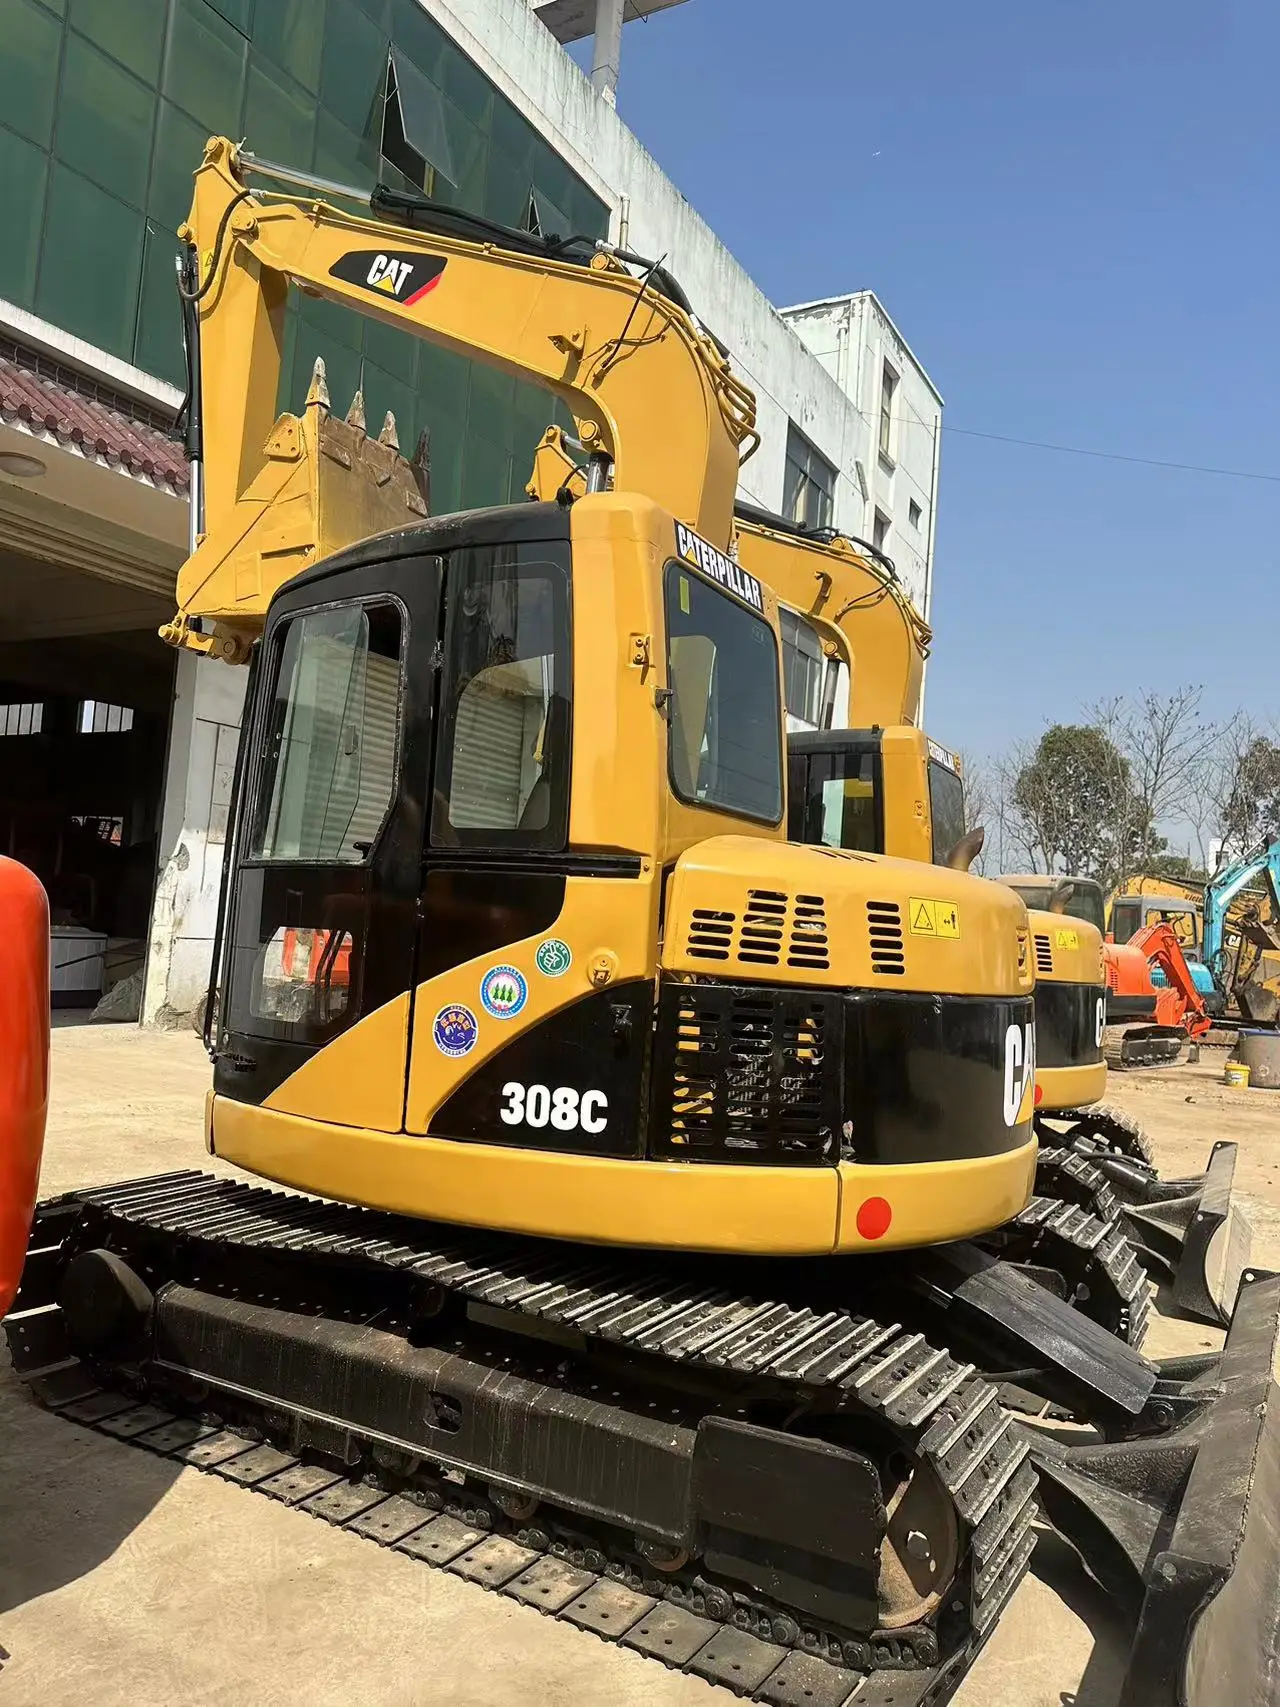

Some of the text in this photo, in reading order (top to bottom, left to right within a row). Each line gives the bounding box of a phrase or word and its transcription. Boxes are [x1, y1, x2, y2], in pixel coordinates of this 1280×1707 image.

[366, 254, 414, 296] CAT
[677, 524, 762, 610] CATERPILLAR
[500, 1081, 609, 1134] 308C
[1003, 1021, 1036, 1127] CA
